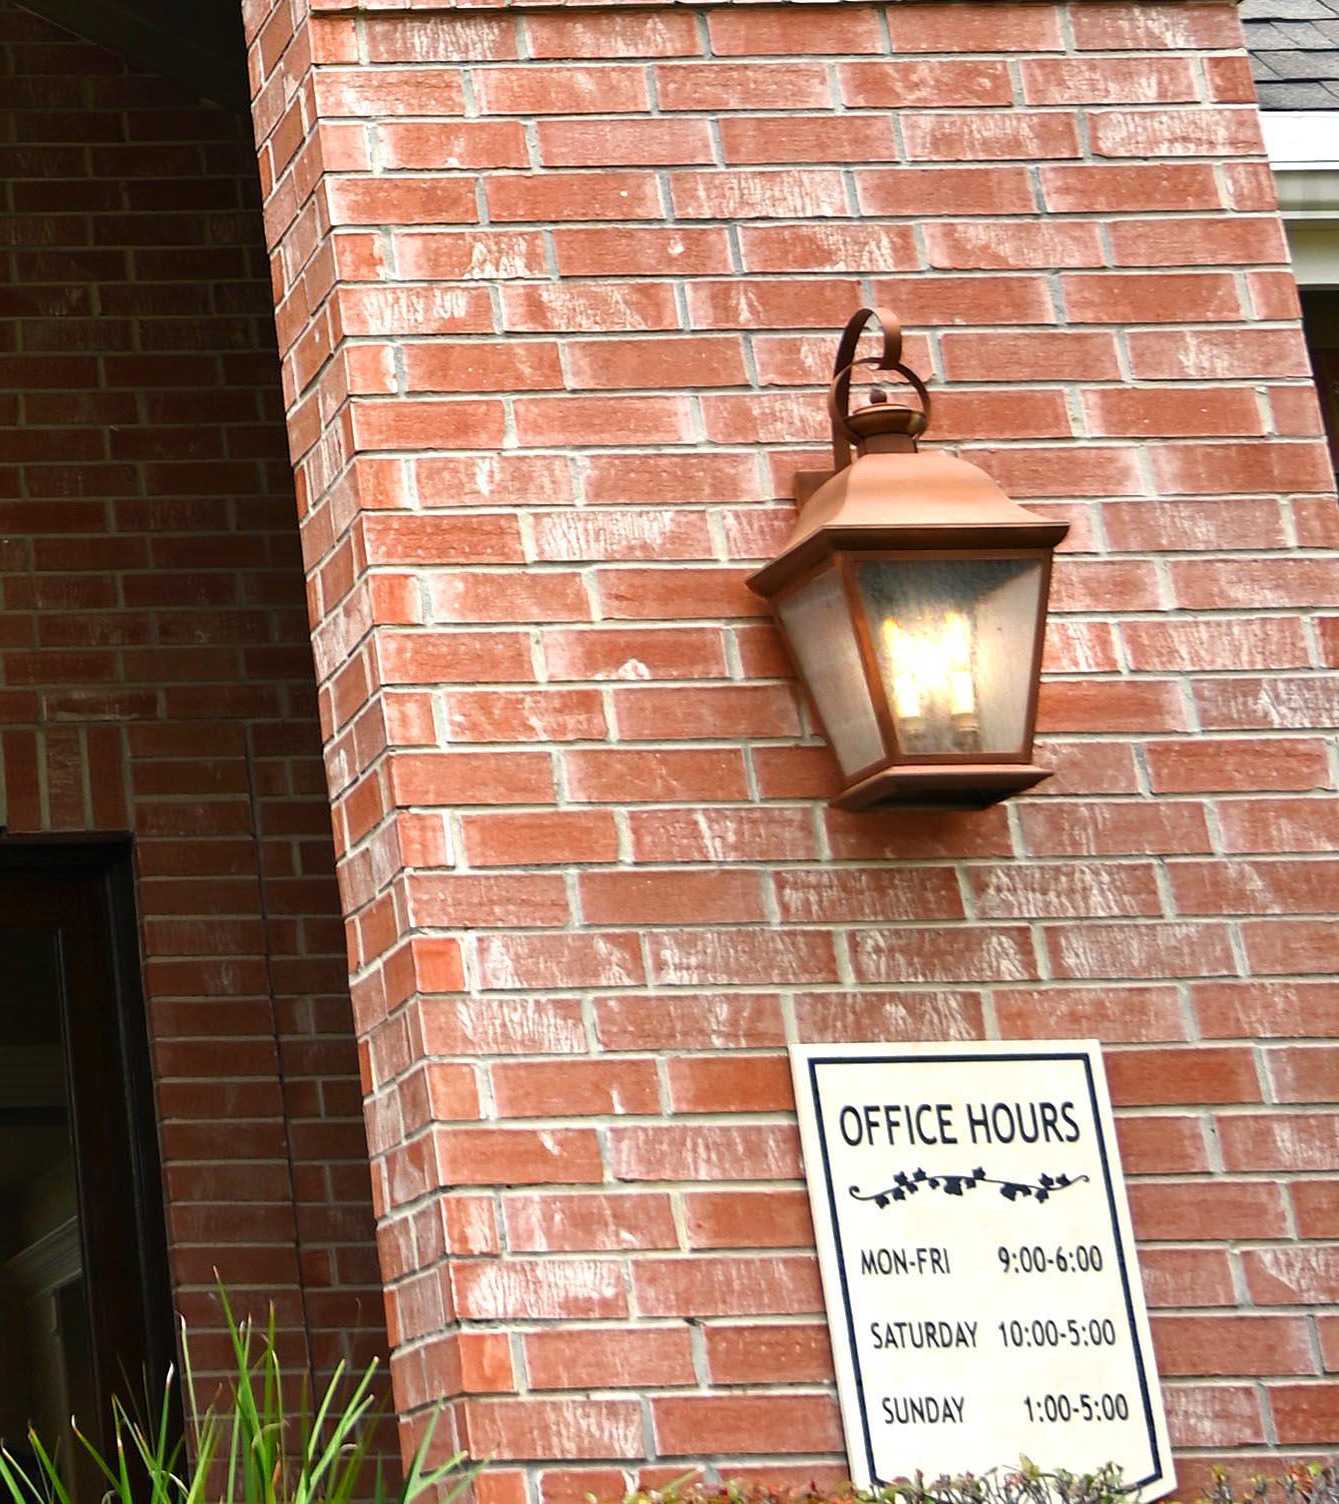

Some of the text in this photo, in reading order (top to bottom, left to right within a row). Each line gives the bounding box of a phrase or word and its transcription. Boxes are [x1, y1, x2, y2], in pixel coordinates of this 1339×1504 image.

[838, 1100, 1082, 1147] OFFICE HOURS
[860, 1244, 1104, 1276] MON-FRI 9:00-6:00
[870, 1318, 1117, 1350] SATURDAY 10:00-5:00
[881, 1393, 1130, 1425] SUNDAY 1:00-5:00
